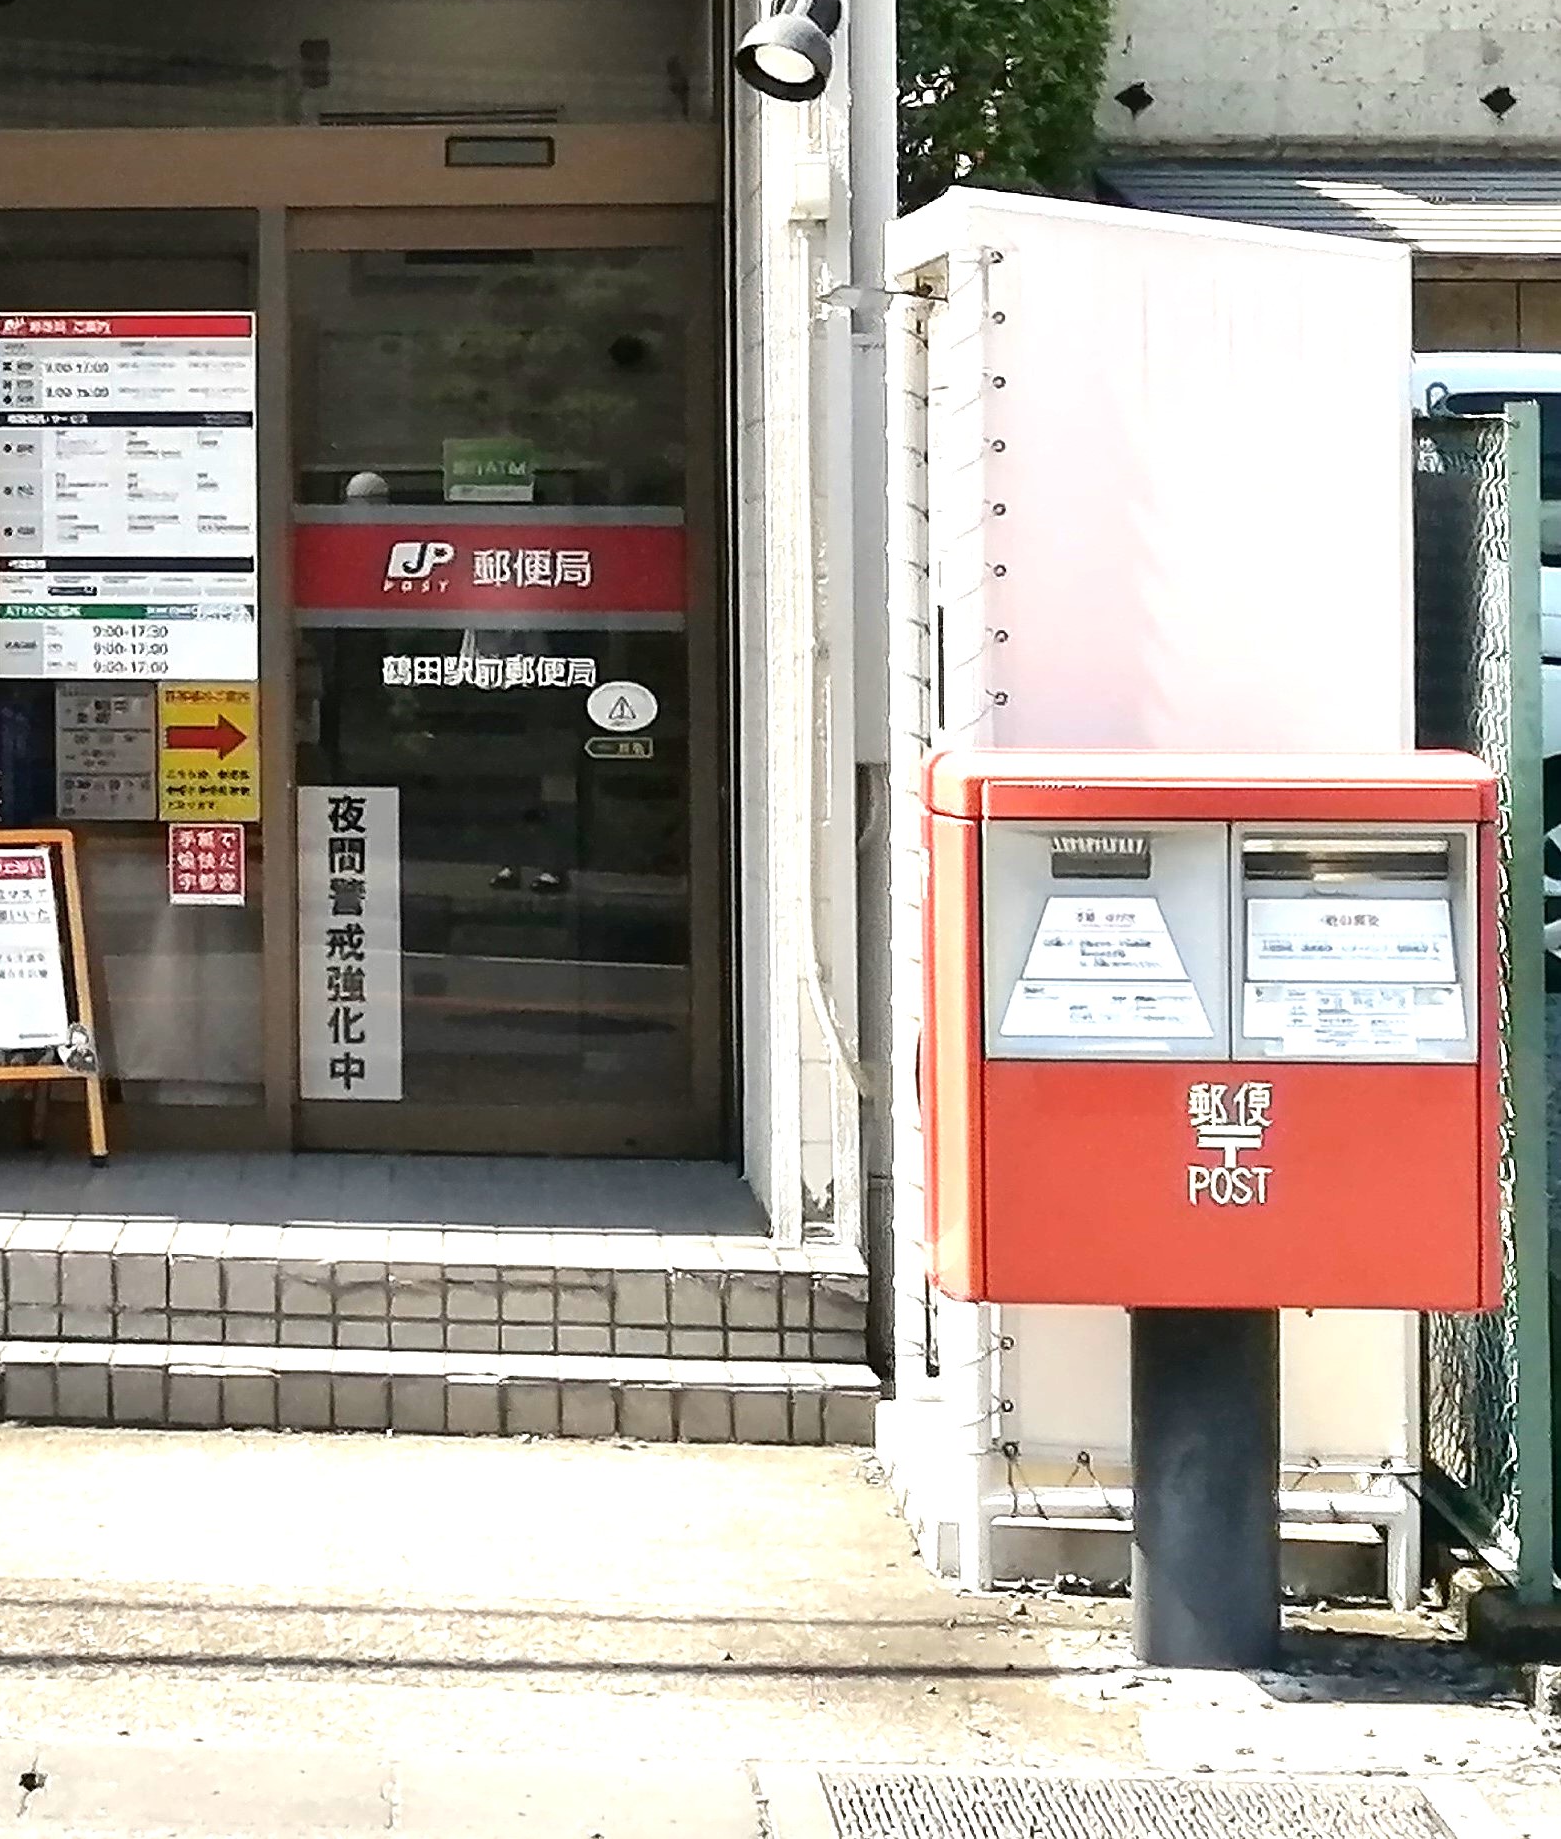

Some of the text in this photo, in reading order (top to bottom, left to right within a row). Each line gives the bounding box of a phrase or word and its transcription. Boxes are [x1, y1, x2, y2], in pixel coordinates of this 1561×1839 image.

[383, 580, 450, 593] POST
[472, 548, 593, 588] 郵便局
[382, 655, 597, 690] 鶴田駅前郵便局
[326, 794, 367, 1091] 夜間警戒強化中
[1188, 1080, 1274, 1128] 郵便
[1188, 1165, 1274, 1207] POST
